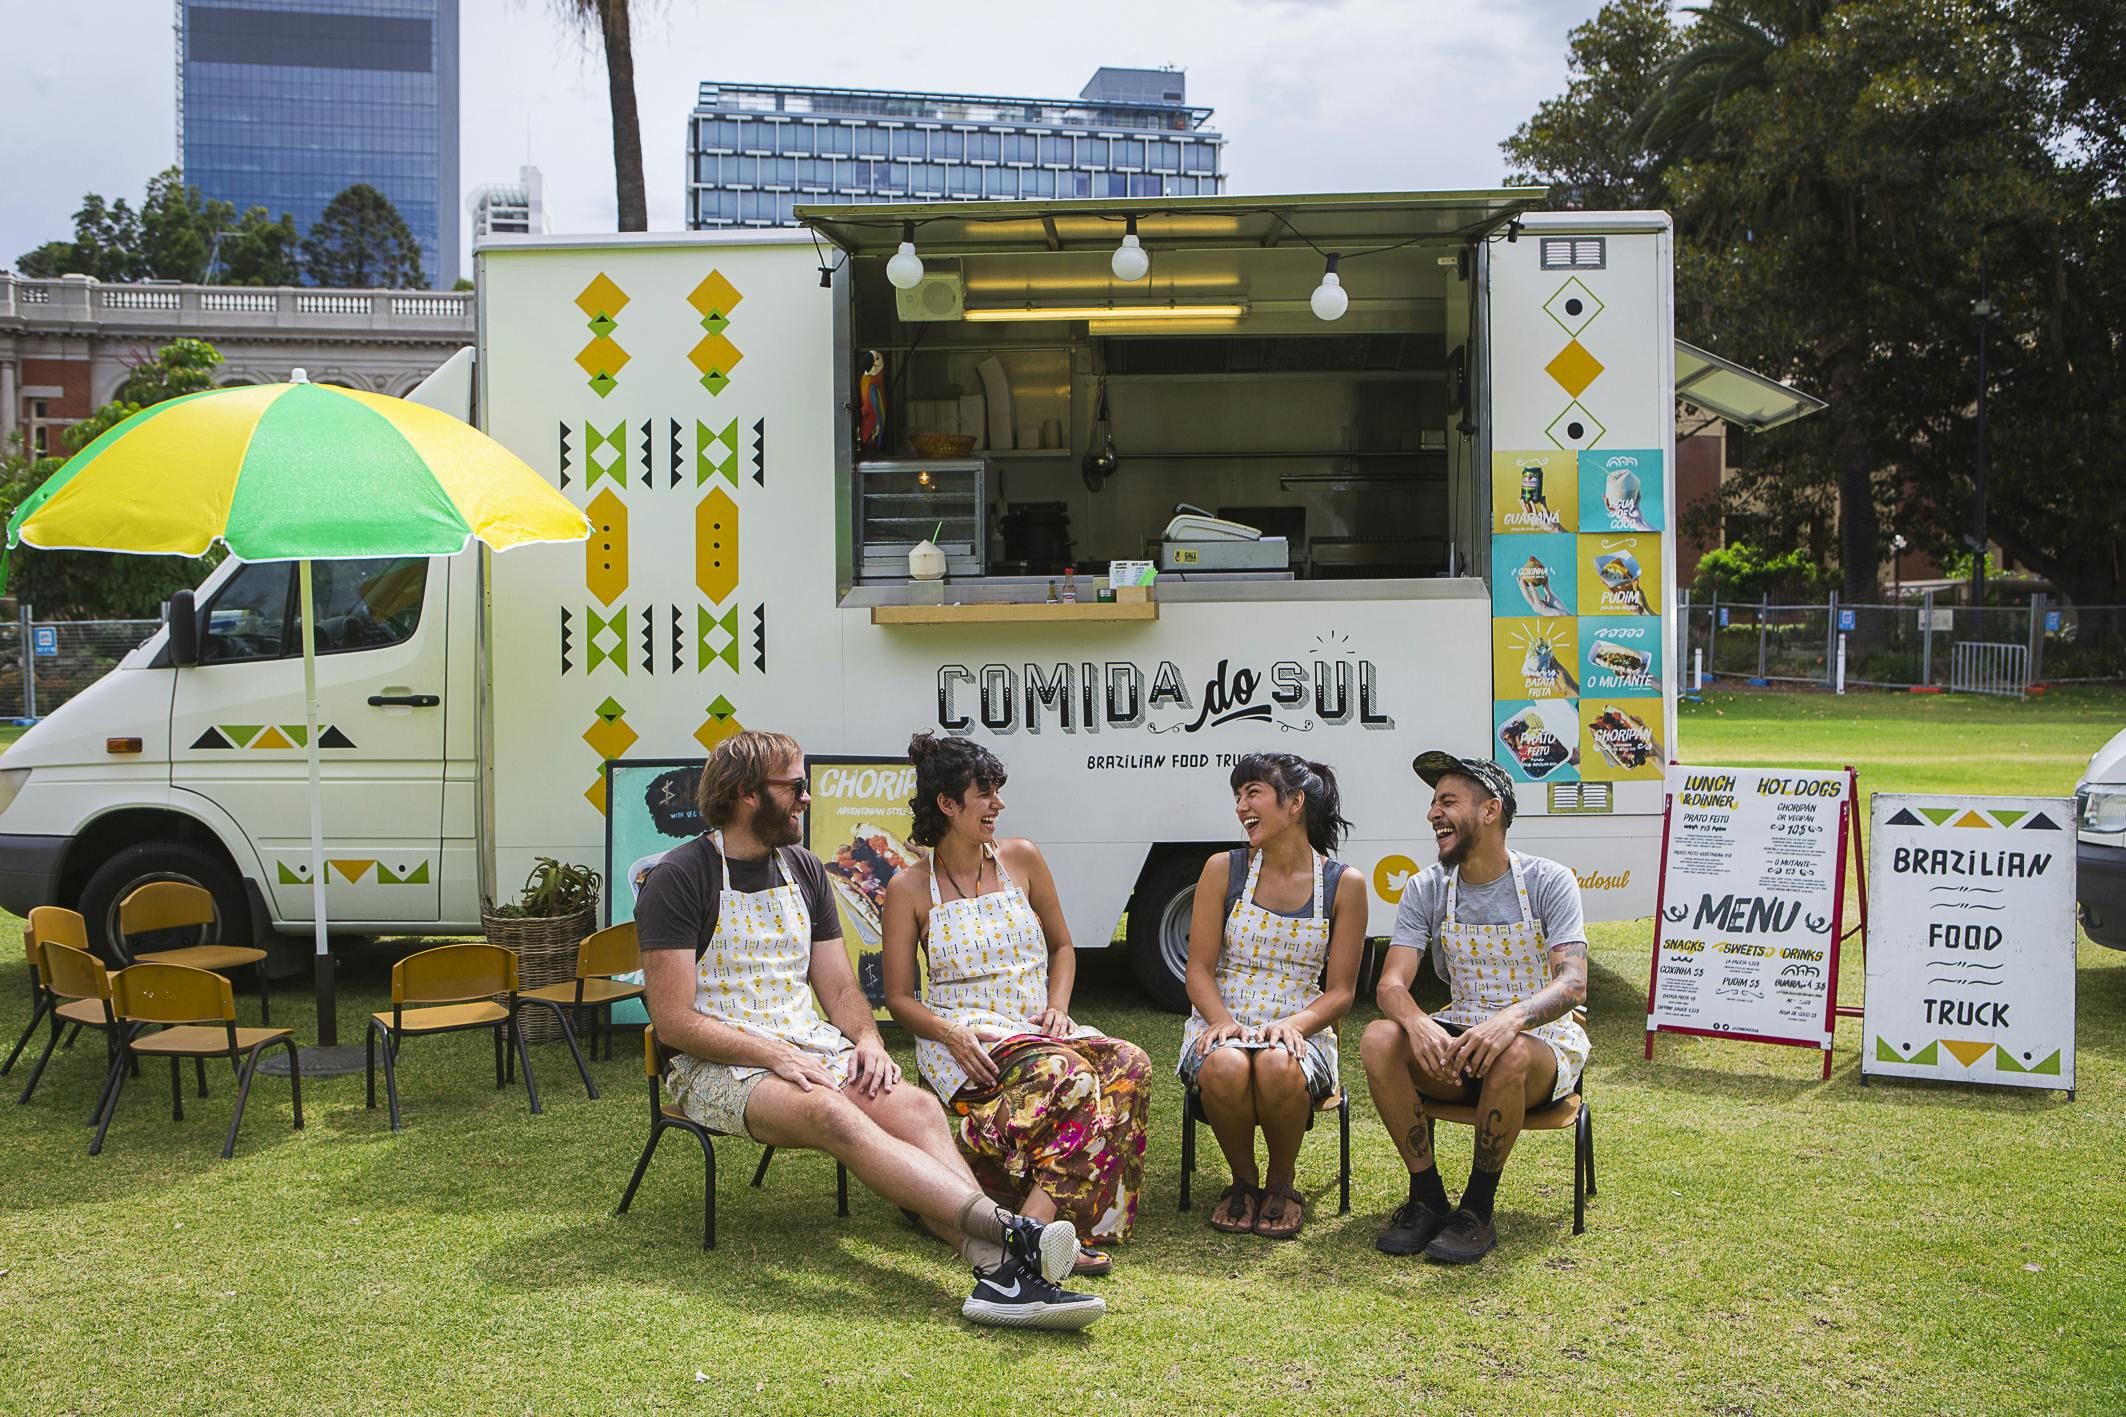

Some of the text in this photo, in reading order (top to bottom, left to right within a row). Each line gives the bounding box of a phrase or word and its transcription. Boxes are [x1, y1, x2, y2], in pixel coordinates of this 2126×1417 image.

[1617, 509, 1629, 519] DE
[1610, 519, 1637, 529] COCO
[1587, 674, 1653, 688] O MUTANTE
[937, 659, 1396, 736] COMIDA do SUL
[1520, 731, 1556, 745] PRATO
[1527, 745, 1550, 756] FEITO
[1172, 754, 1209, 768] FOOD
[1216, 754, 1251, 768] TRU
[1684, 775, 1736, 792] LUNCH
[1757, 778, 1842, 797] HOT DOGS
[1683, 813, 1730, 823] PRATO FEITO
[1787, 824, 1806, 836] 10$
[1780, 860, 1810, 868] MUTANTE
[1571, 868, 1630, 890] adosul
[1692, 893, 1802, 933] MENU
[1929, 923, 2003, 951] FOOD
[1663, 939, 1706, 952] SNACKS
[1723, 943, 1766, 957] SWEETS
[1693, 968, 1704, 978] 5$
[1749, 980, 1760, 988] 5$
[1814, 982, 1826, 992] 3$
[1923, 998, 2010, 1028] TRUCK
